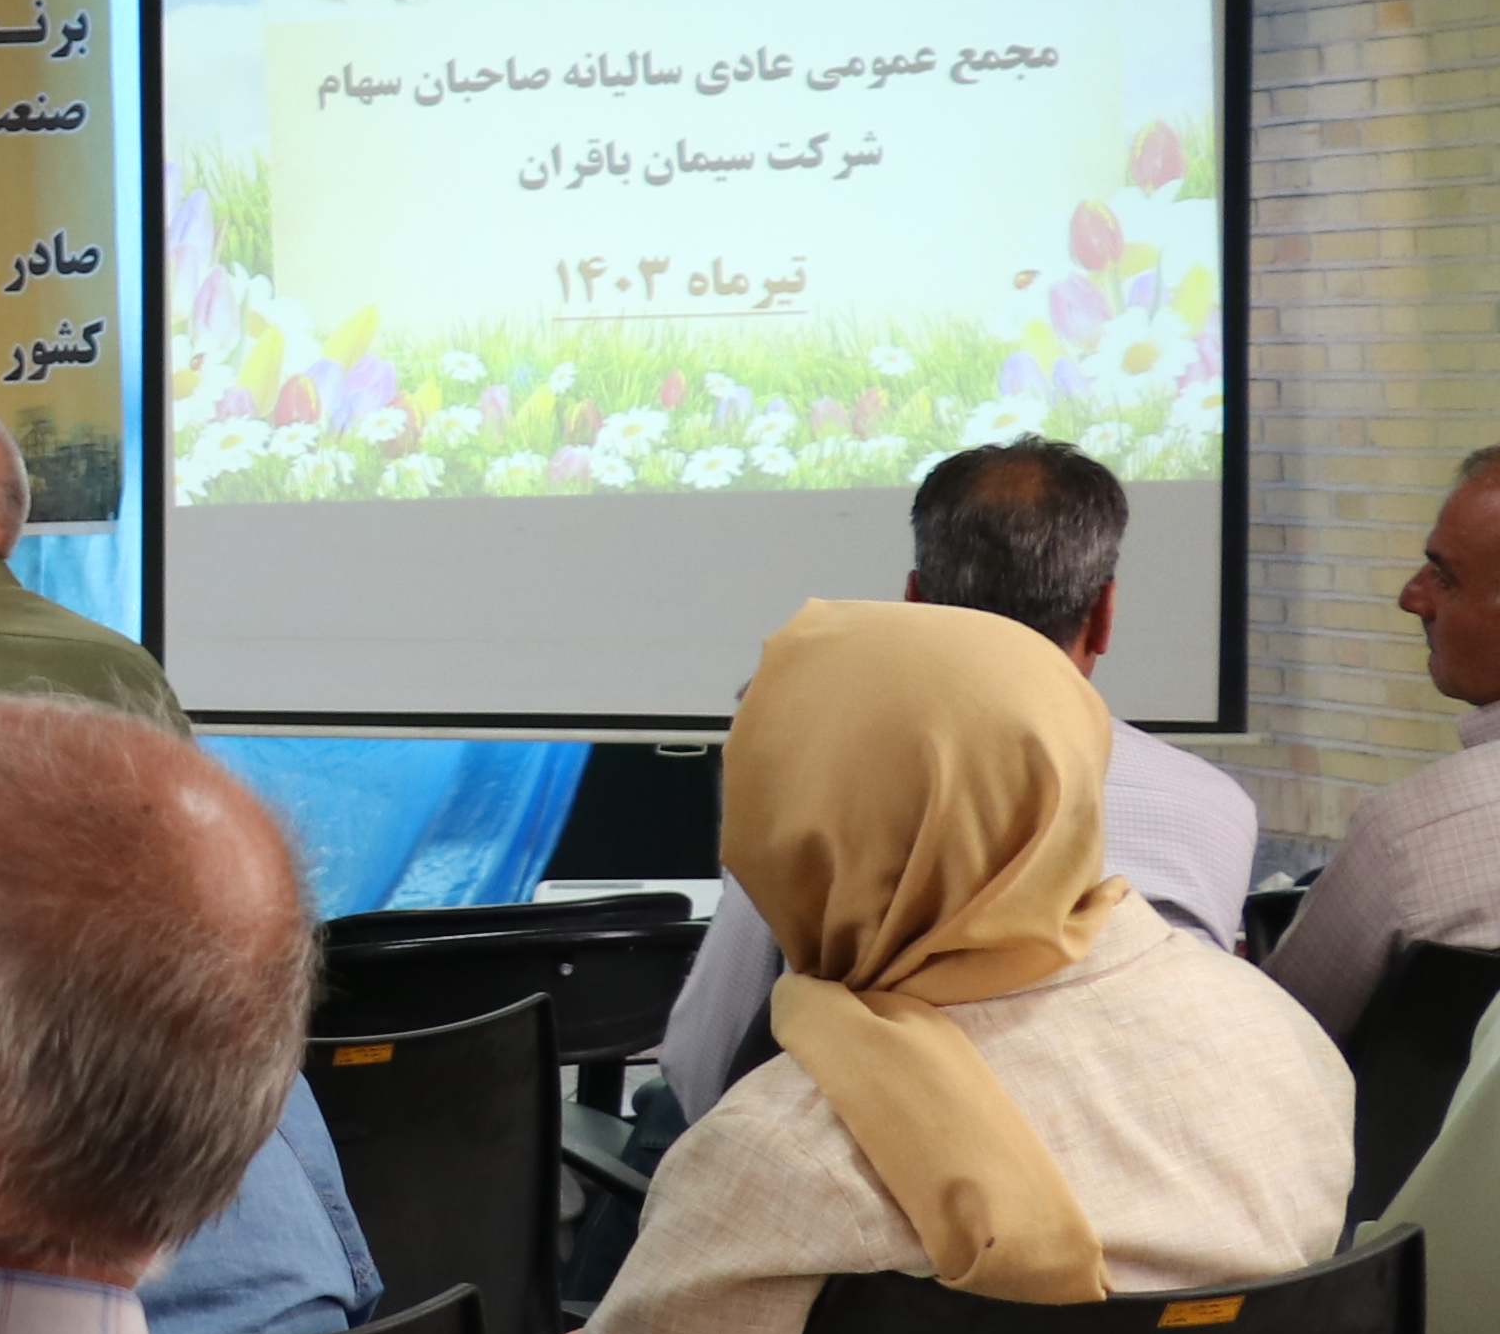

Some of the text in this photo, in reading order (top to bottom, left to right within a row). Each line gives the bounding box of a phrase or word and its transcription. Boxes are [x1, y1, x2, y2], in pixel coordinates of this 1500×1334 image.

[317, 43, 1060, 110] مجمع عمومی عادی سالیانه صاحبان سهام
[518, 130, 884, 190] شرکت سیمان باقران
[3, 229, 100, 292] صادر
[555, 255, 671, 304] ۱۴۰۳
[3, 317, 106, 383] کشور
